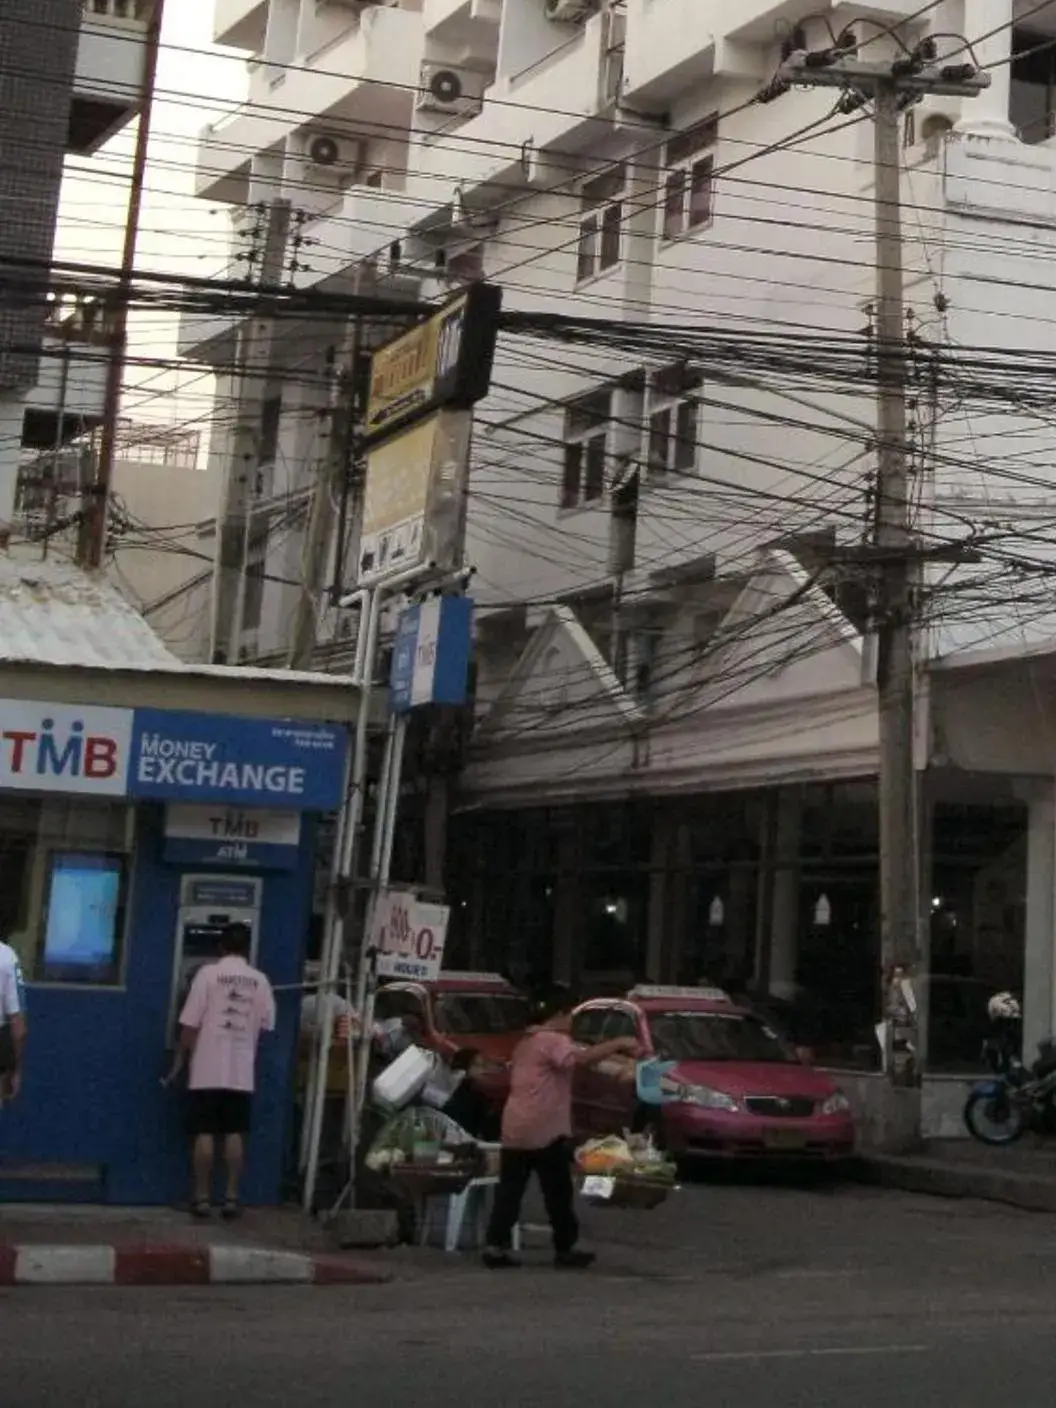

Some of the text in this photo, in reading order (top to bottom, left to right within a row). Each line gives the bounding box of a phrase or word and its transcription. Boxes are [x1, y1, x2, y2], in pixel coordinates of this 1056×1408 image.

[3, 718, 118, 779] TMB
[141, 732, 216, 760] MONEY
[137, 755, 305, 793] EXCHANGE
[209, 809, 259, 838] TMB
[217, 841, 247, 860] ATM
